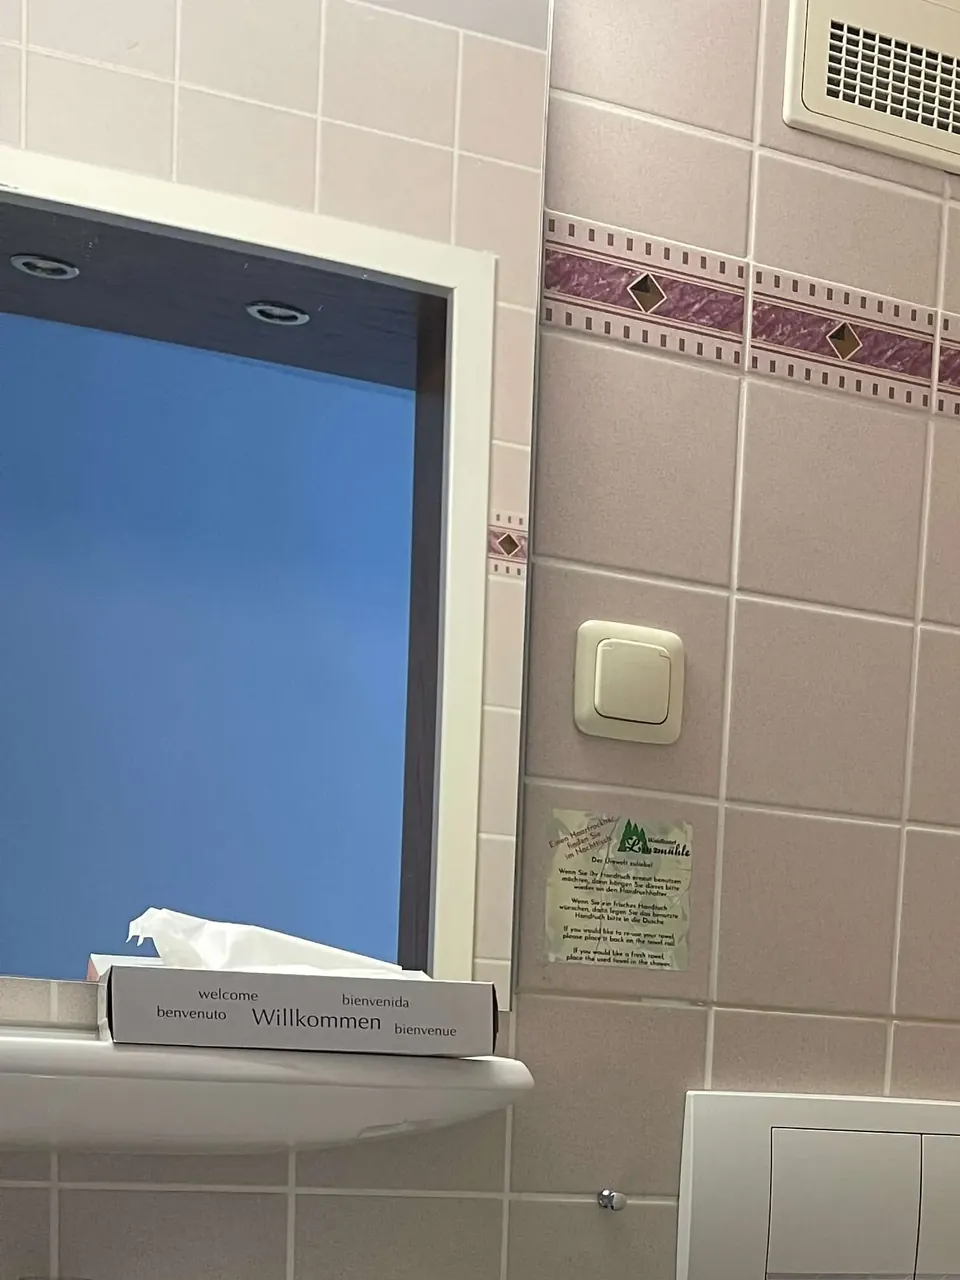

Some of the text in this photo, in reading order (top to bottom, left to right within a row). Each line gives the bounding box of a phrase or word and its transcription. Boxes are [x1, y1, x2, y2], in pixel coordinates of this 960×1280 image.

[198, 987, 259, 1002] welcome
[342, 993, 410, 1008] bienvenida
[156, 1005, 228, 1021] benvenuto
[252, 1006, 382, 1031] Willkommen
[394, 1023, 458, 1038] bienvenue
